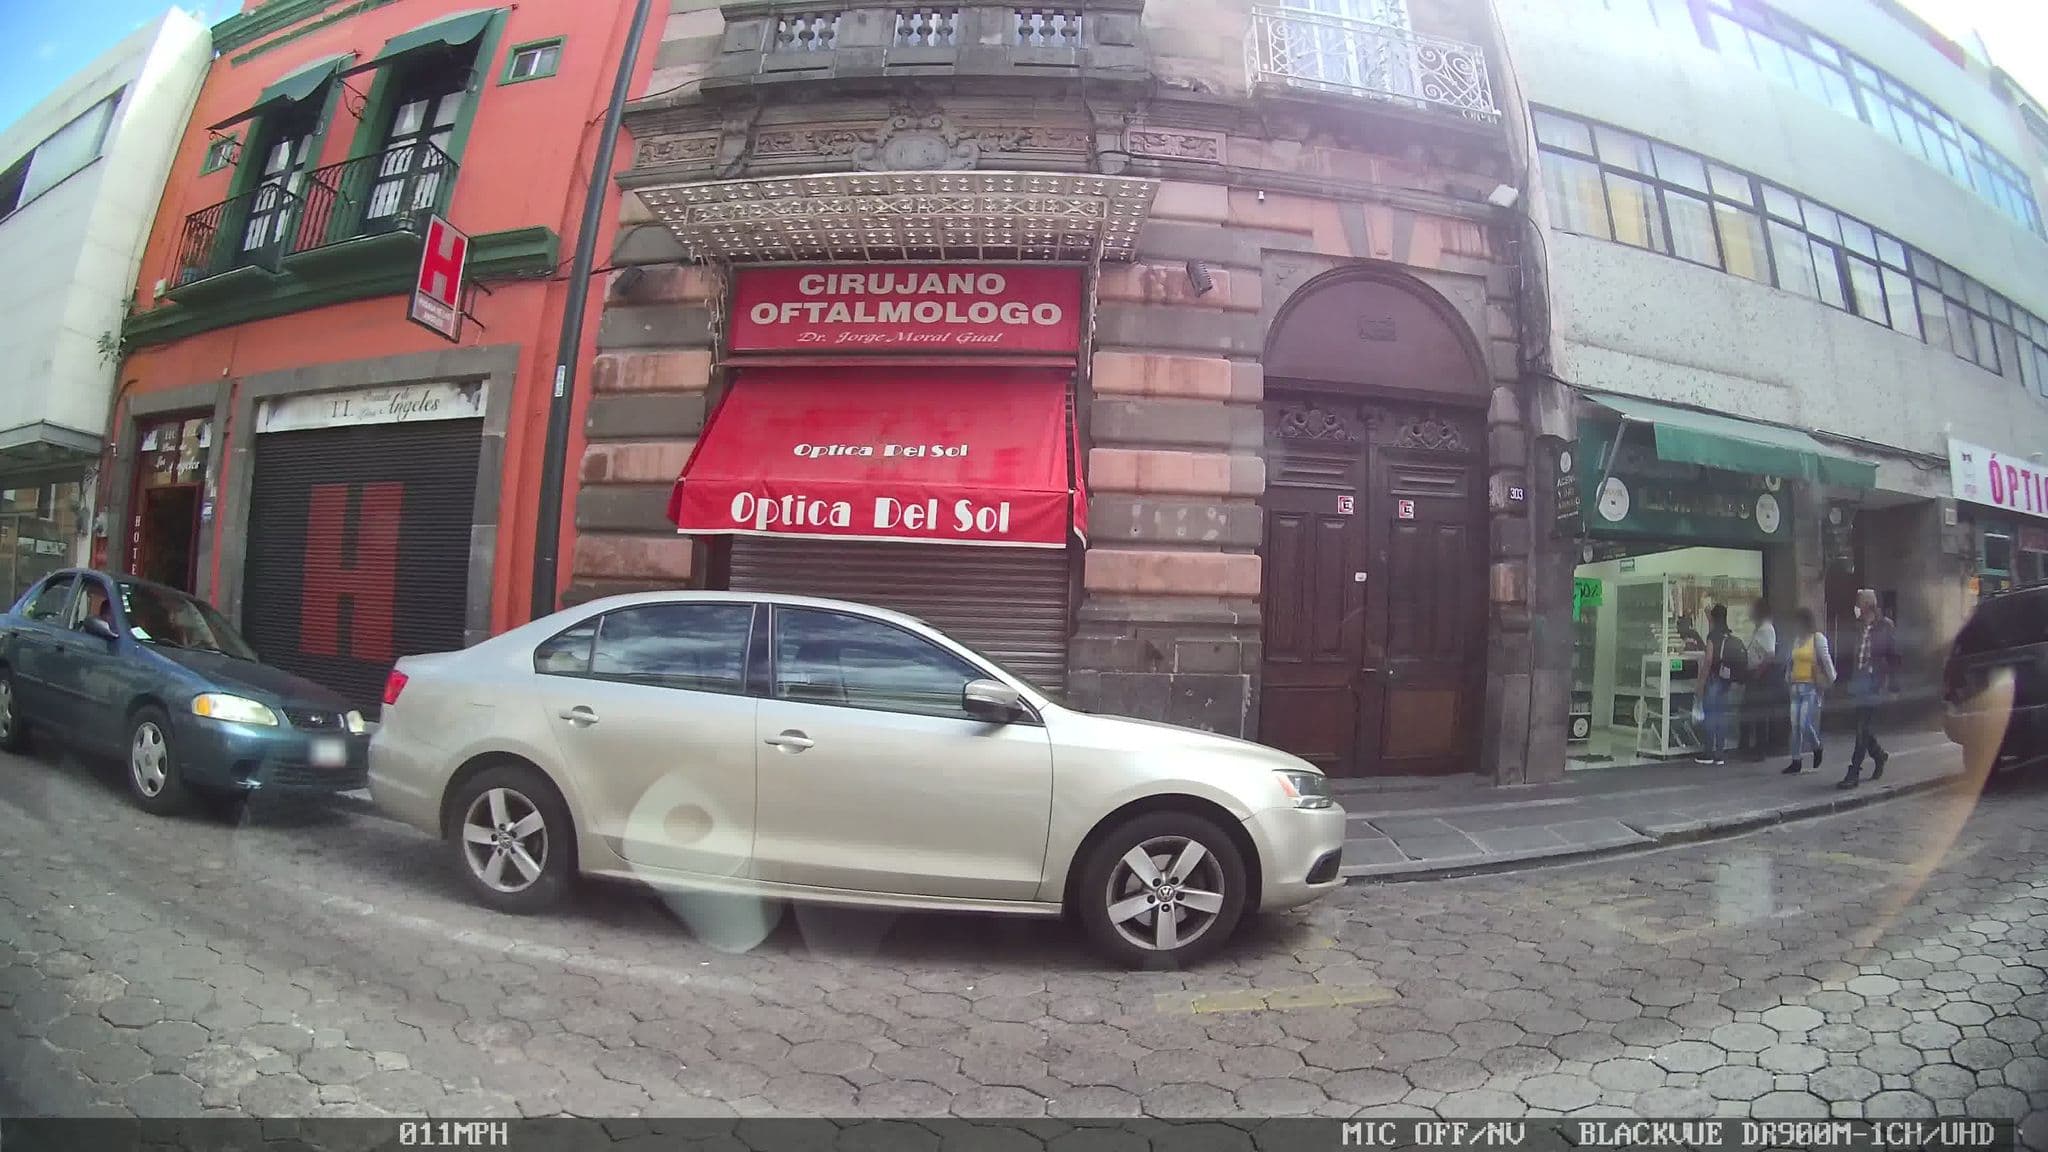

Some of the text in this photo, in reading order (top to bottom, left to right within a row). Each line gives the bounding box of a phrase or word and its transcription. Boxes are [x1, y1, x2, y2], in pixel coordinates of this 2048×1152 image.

[419, 221, 466, 305] H
[799, 273, 1006, 296] CIRUJANO
[750, 301, 1062, 325] OFTALMOLOGO
[796, 331, 1003, 344] Dr. Jorge Moral Gual
[793, 443, 969, 458] Optica Del Sol
[1510, 487, 1523, 500] 303
[1989, 451, 2048, 514] ÓPTI
[730, 491, 1011, 533] Optica Del Sol
[131, 515, 141, 576] HOTE
[299, 481, 405, 664] H
